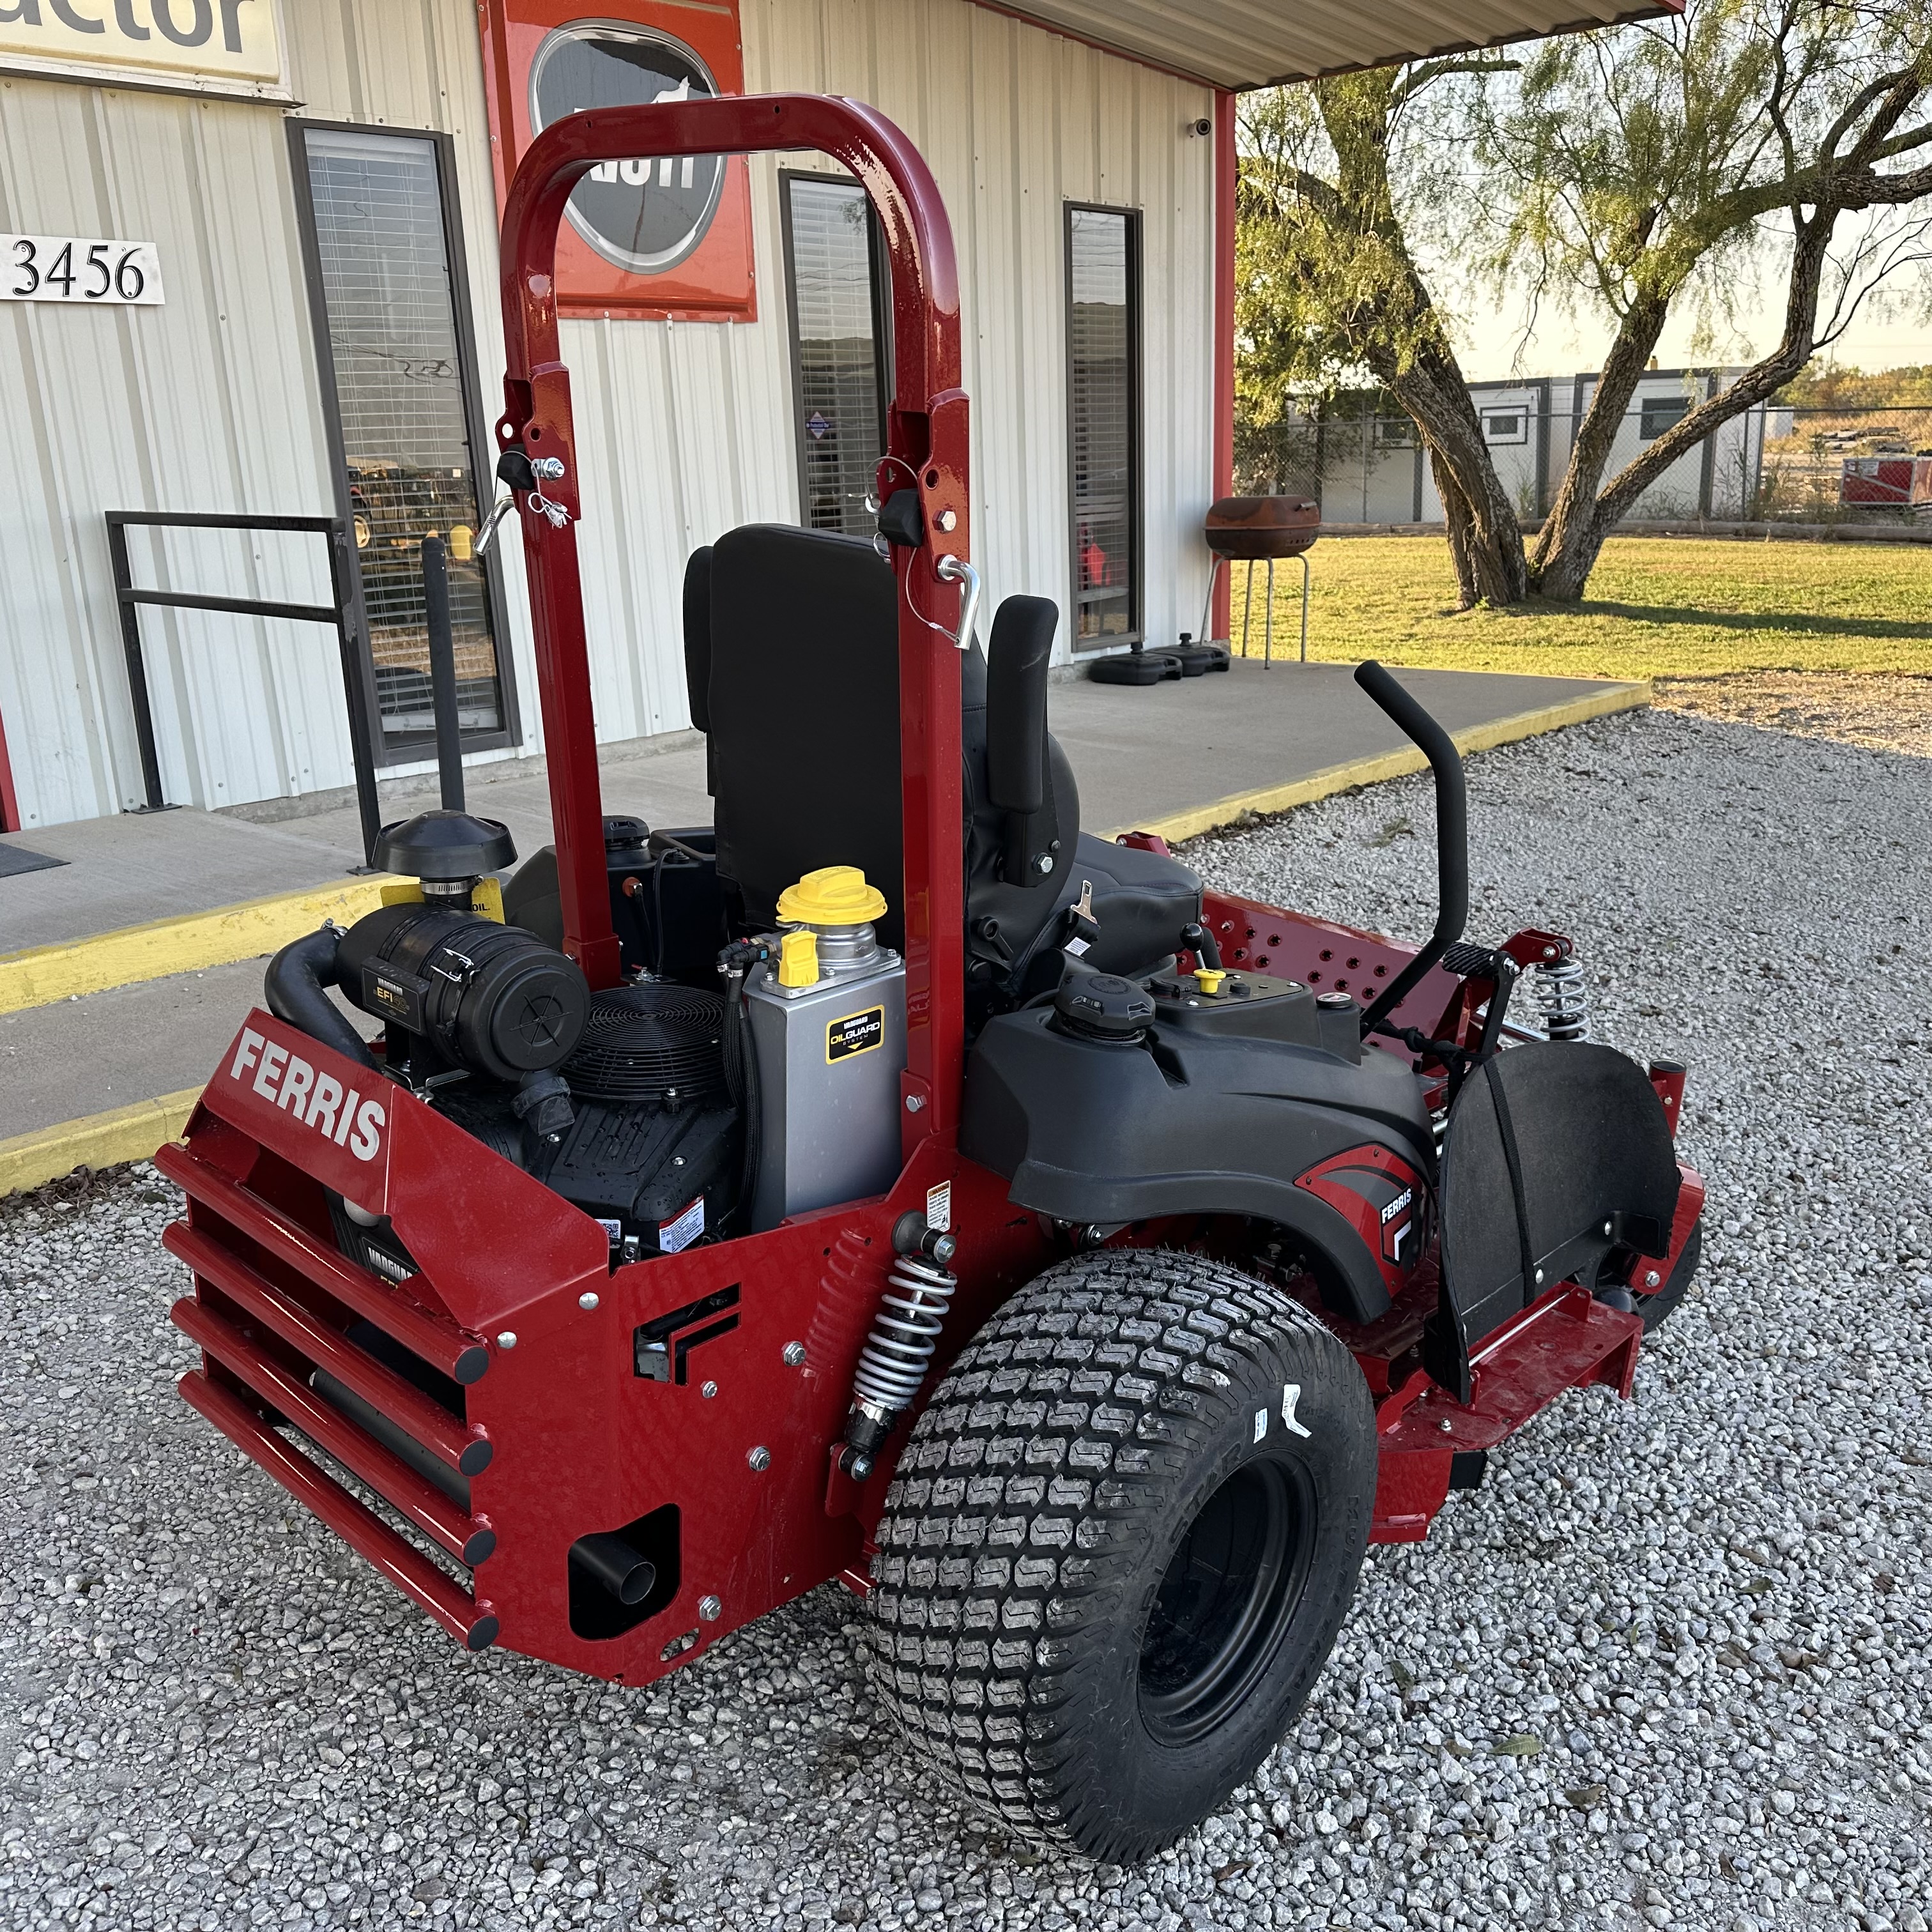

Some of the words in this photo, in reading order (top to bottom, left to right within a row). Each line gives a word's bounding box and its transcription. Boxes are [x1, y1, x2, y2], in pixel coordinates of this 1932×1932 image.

[12, 239, 144, 300] 3456
[230, 1027, 386, 1162] FERRIS
[1381, 1188, 1412, 1224] FERRIS
[368, 1246, 413, 1282] VANGUA
